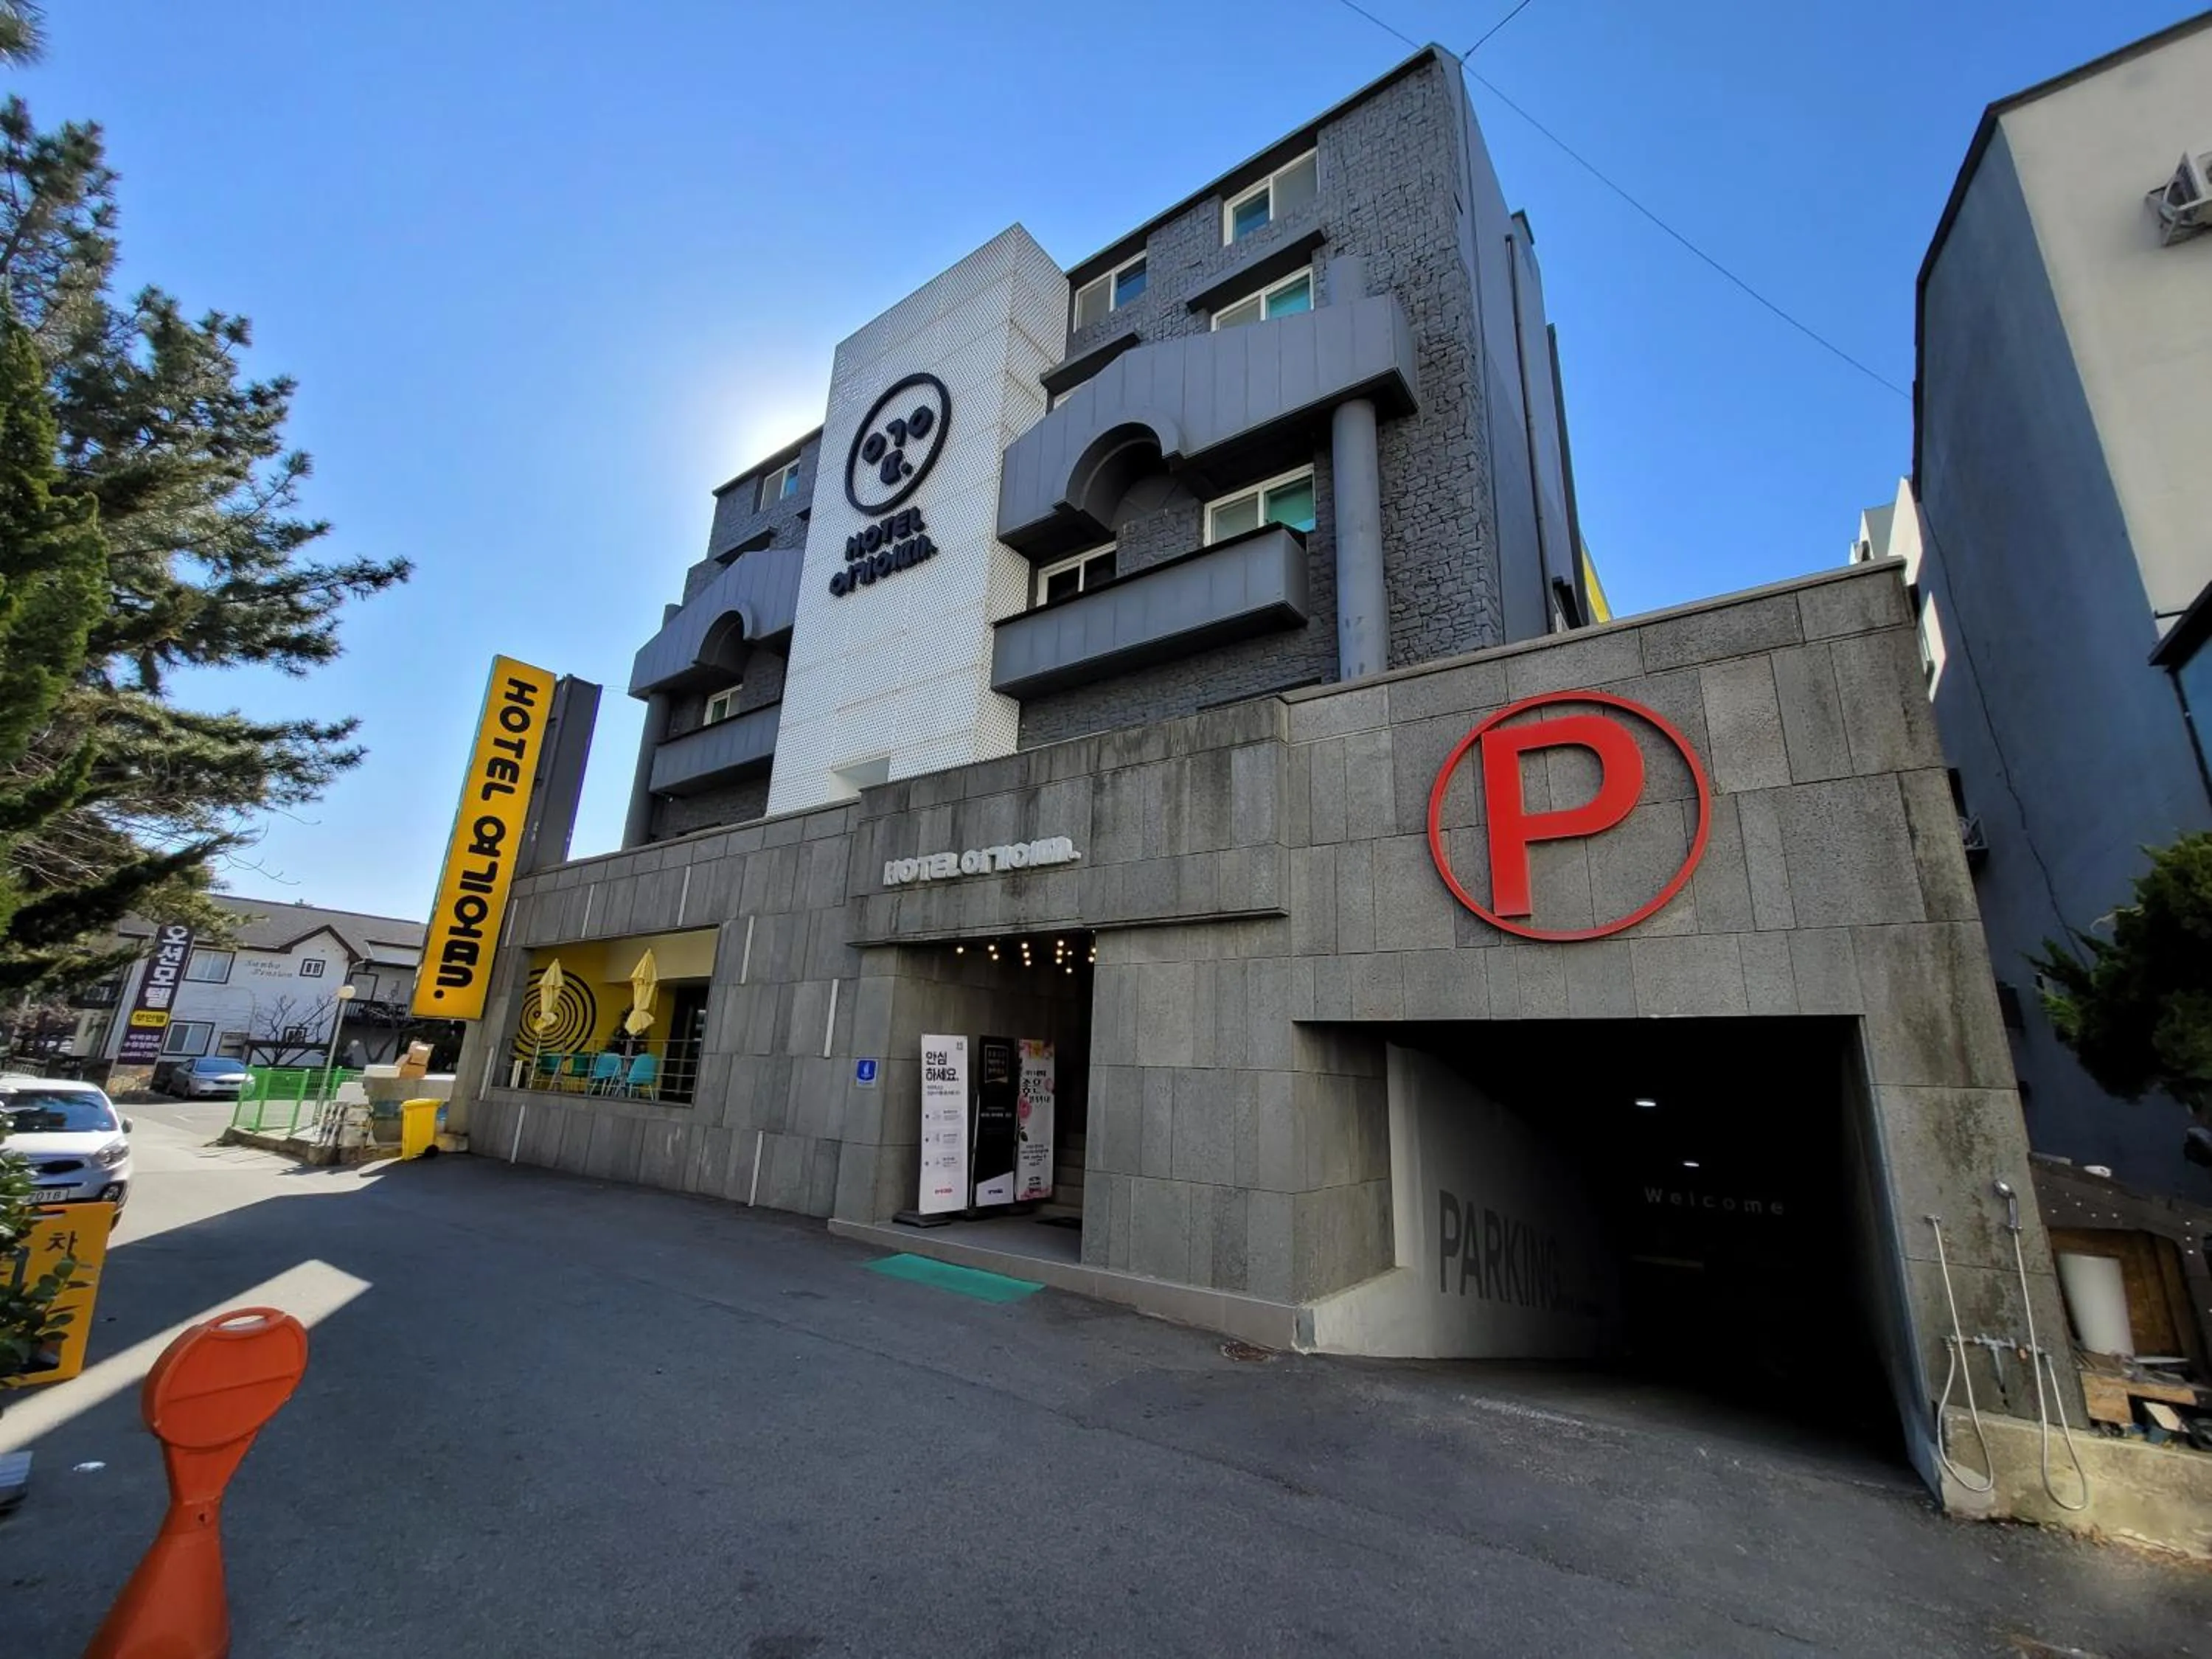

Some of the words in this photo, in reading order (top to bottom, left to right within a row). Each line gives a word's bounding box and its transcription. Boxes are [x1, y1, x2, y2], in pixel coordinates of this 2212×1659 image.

[845, 506, 925, 563] HOTEL
[481, 676, 538, 802] HOTEL
[1481, 714, 1645, 917] P
[883, 852, 961, 886] HOTEL
[145, 925, 189, 1009] 오션모텔
[925, 1051, 947, 1065] 안심
[925, 1068, 959, 1082] 하세요.
[1644, 1186, 1786, 1217] Welcome
[1439, 1189, 1561, 1312] PARKING
